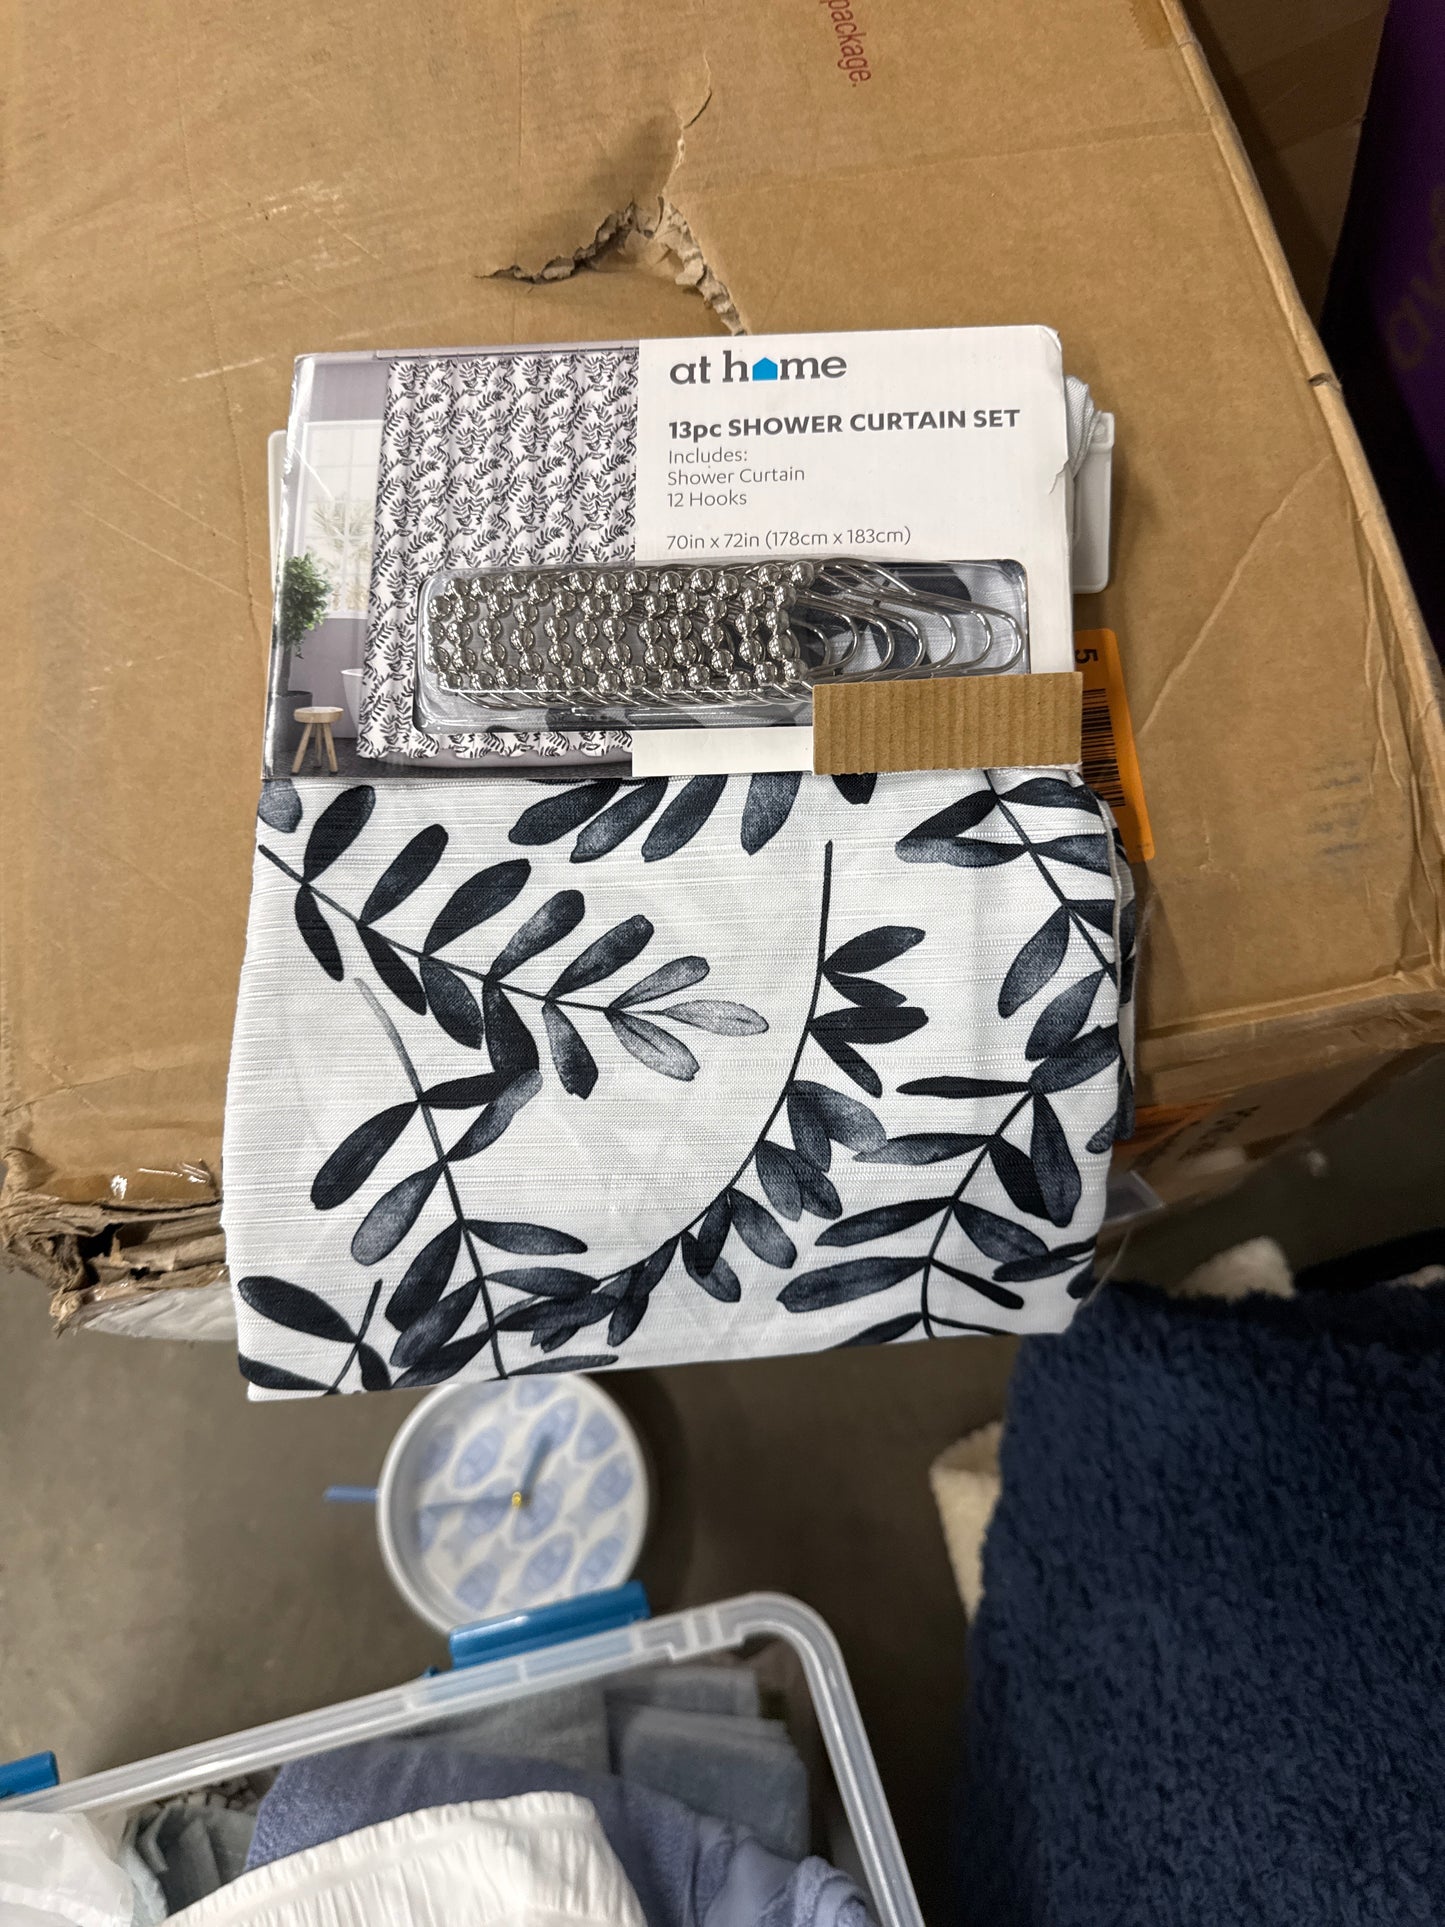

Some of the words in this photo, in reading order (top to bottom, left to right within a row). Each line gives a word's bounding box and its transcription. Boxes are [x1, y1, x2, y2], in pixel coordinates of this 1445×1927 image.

[670, 356, 711, 385] at
[669, 421, 721, 443] 13pc
[729, 415, 843, 436] SHOWER
[850, 410, 965, 431] CURTAIN
[974, 409, 1020, 427] SET
[670, 447, 747, 464] Includes:
[668, 470, 734, 485] Shower
[740, 467, 804, 482] Curtain
[668, 493, 683, 507] 12
[690, 489, 746, 506] Hooks
[667, 535, 704, 549] 70in
[711, 538, 719, 548] x
[724, 533, 759, 548] 72in
[766, 531, 827, 549] (178cm
[833, 534, 842, 544] x
[847, 526, 910, 545] 183cm)
